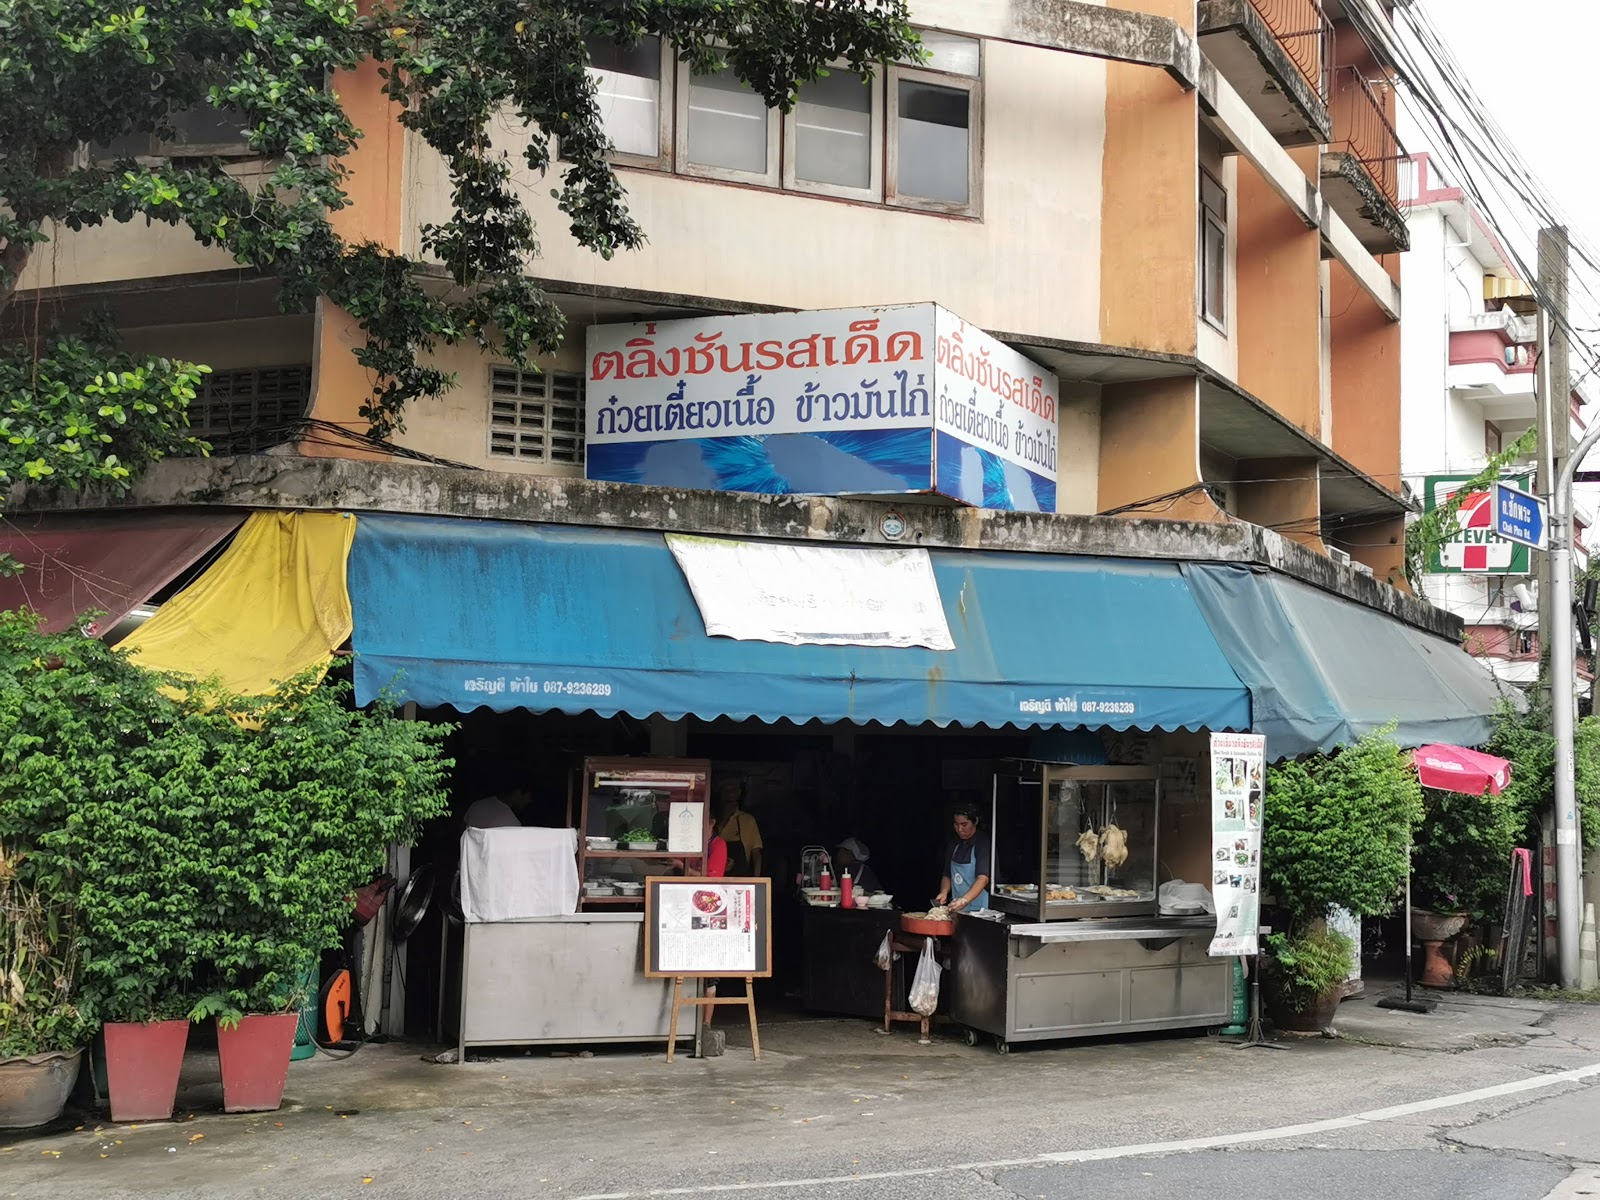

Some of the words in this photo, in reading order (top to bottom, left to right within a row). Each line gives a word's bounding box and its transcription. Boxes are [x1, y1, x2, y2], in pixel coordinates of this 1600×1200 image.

[589, 318, 923, 380] ตลิ่งชันรสเด็ด
[937, 321, 1056, 424] ตลิ่งชันรสเด็ด
[596, 374, 775, 434] ก๋วยเตี๋ยวเนื้อ
[796, 370, 930, 424] ข้าวมันไก่
[939, 383, 1009, 450] ก๋วยเตี๋ยวเนื้อ
[1015, 420, 1057, 473] ข้าวมันไก่
[1502, 492, 1531, 524] ถ.ชักพระ
[543, 681, 612, 697] 087-9236289
